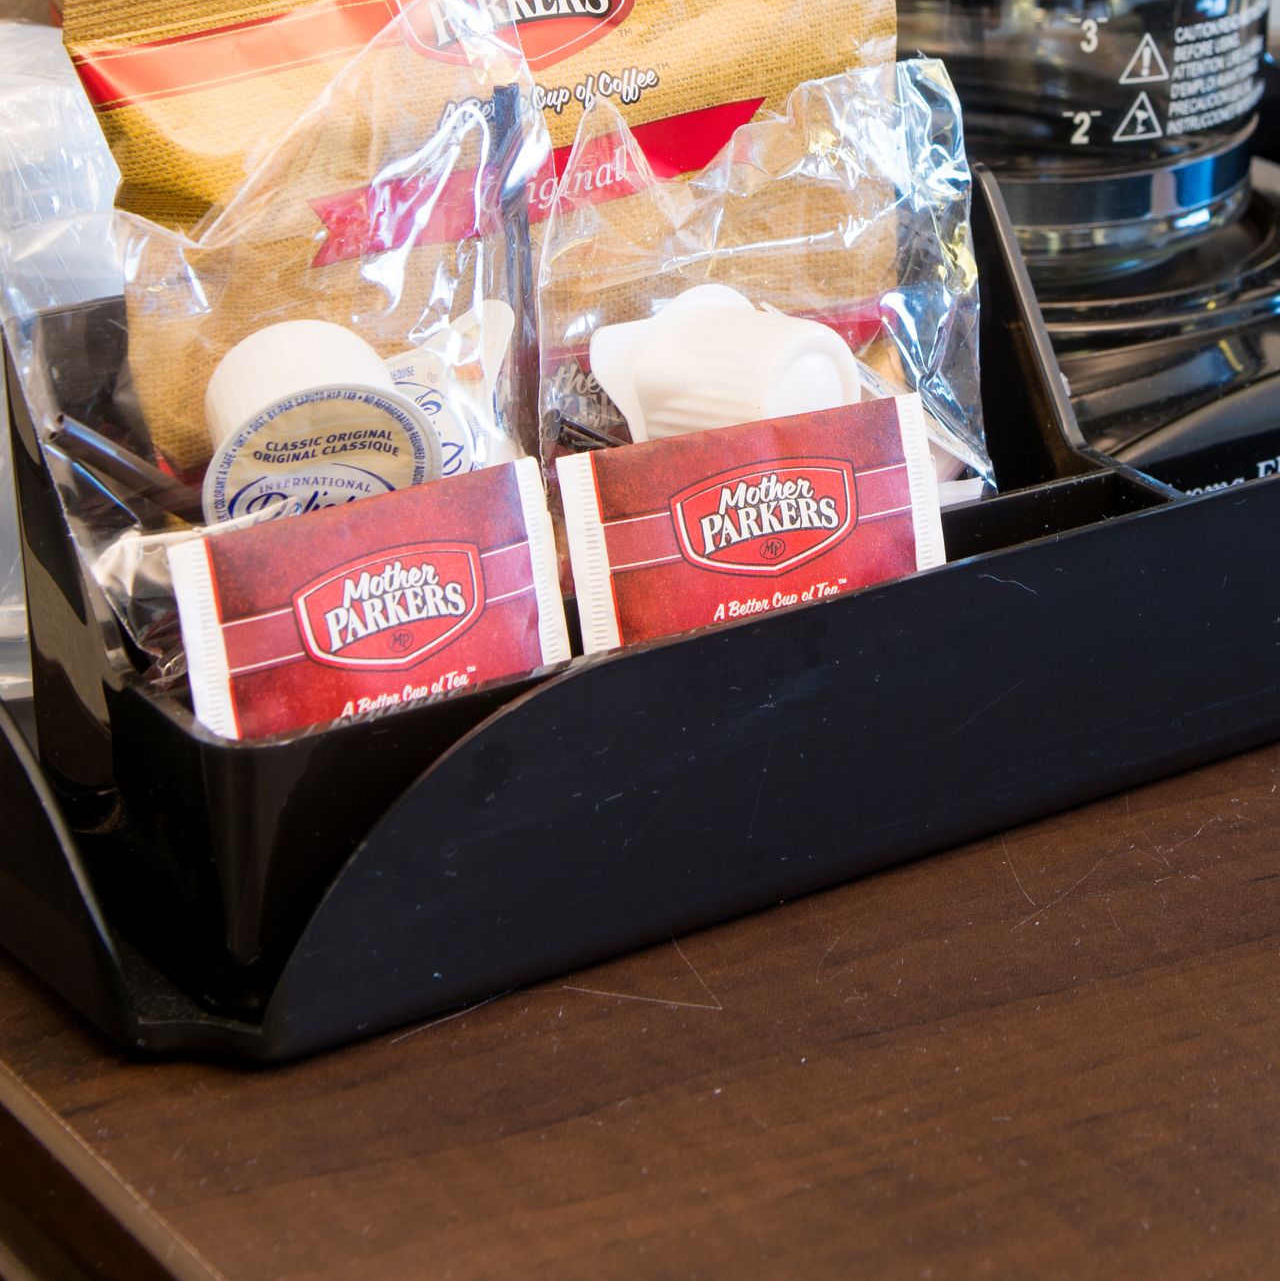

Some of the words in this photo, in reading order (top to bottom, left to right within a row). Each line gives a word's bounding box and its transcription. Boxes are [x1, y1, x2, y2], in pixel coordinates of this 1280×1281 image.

[1080, 18, 1099, 54] 3
[1070, 111, 1091, 145] 2
[253, 448, 318, 464] ORIGINAL
[321, 440, 400, 457] CLASSIQUE
[265, 436, 323, 452] CLASSIC
[325, 429, 393, 444] ORIGINAL
[259, 476, 372, 494] INTERNATIONAL
[718, 472, 815, 516] Mother
[700, 497, 840, 556] PARKERS
[342, 560, 439, 608] Mother
[323, 582, 467, 653] PARKERS
[713, 603, 726, 621] A
[728, 597, 770, 617] Better
[772, 591, 798, 608] Cup
[340, 700, 355, 719] A
[357, 692, 400, 714] Better
[402, 684, 429, 702] Cup
